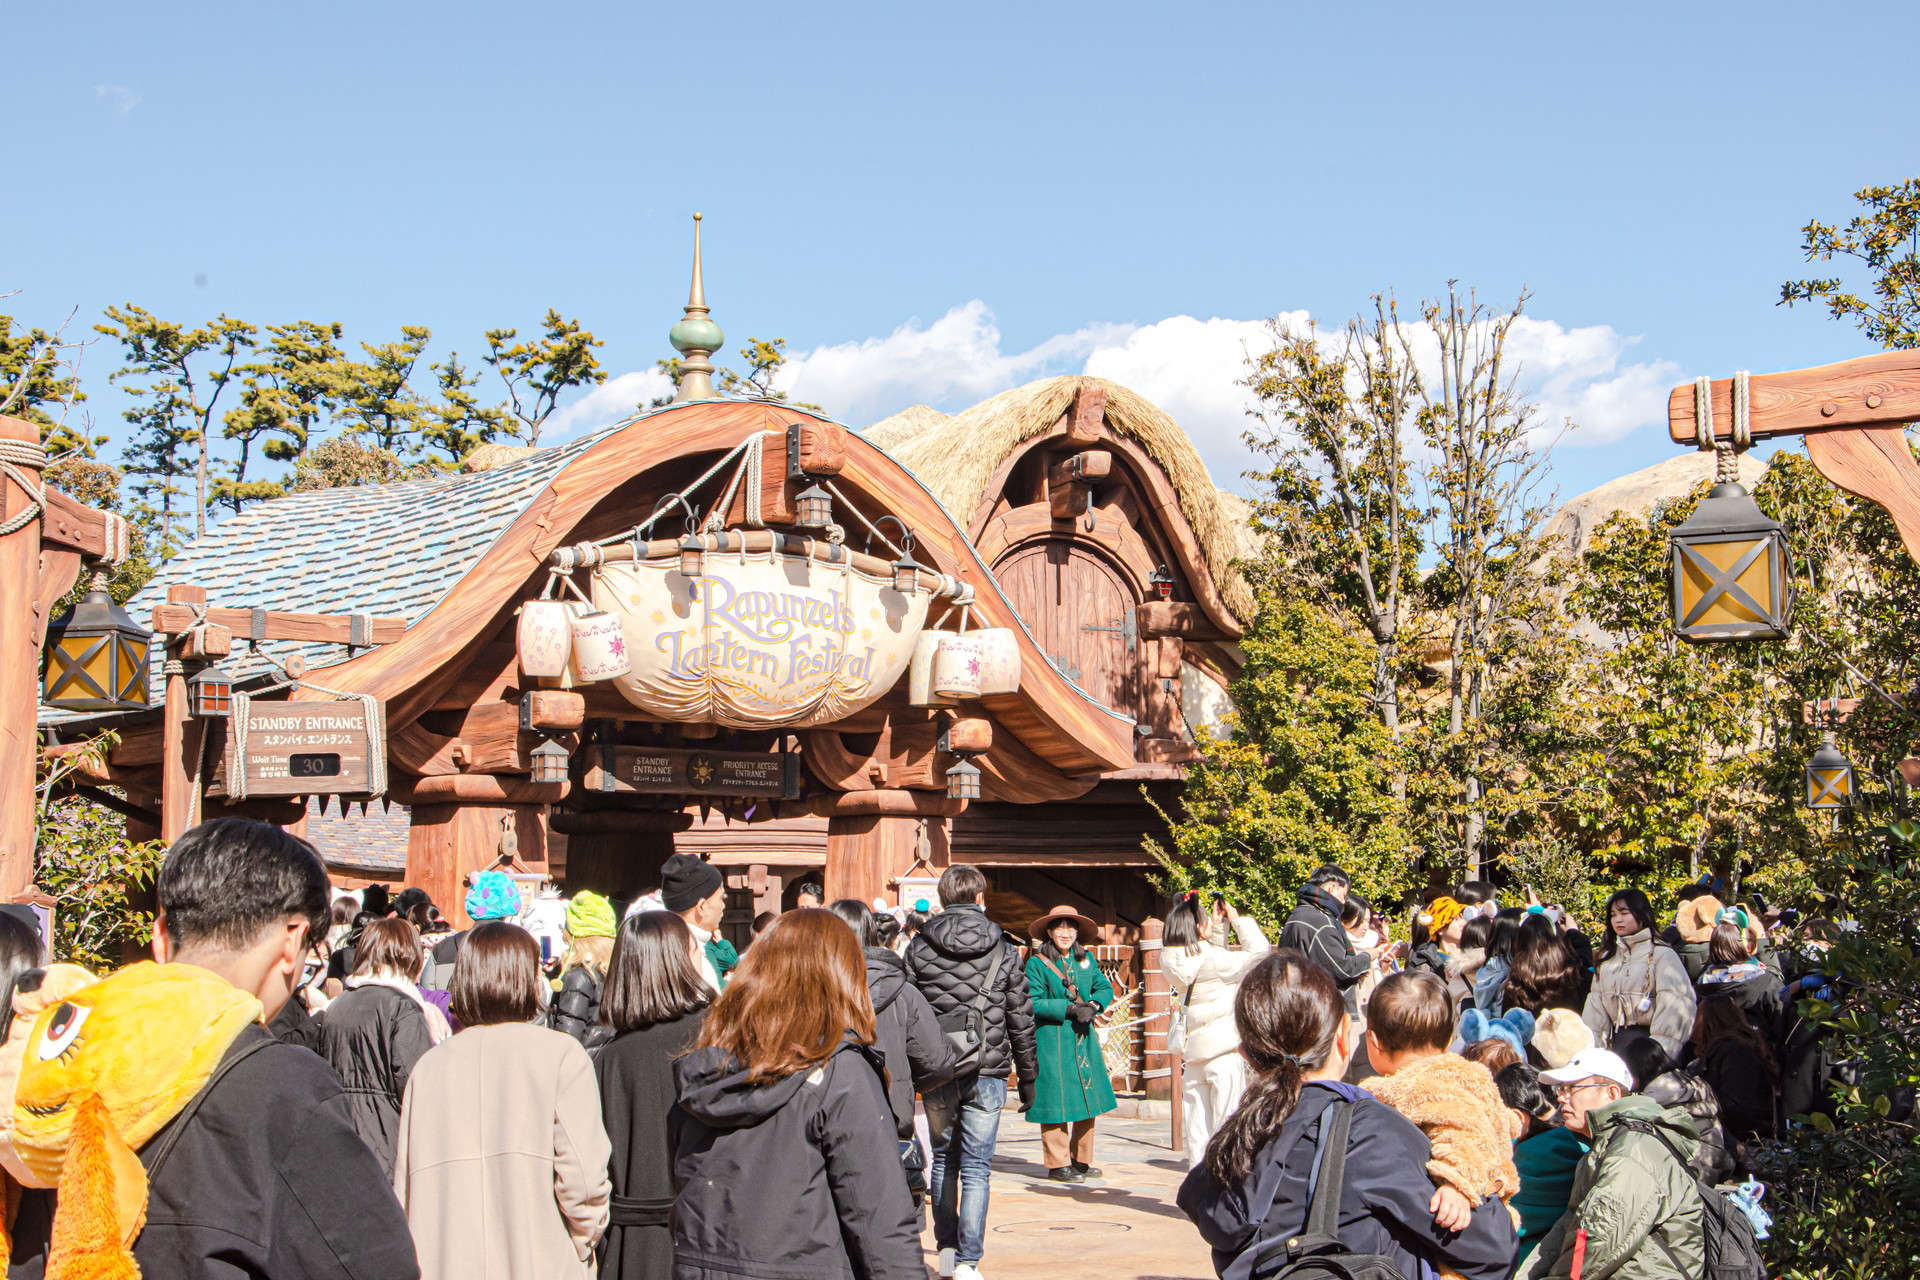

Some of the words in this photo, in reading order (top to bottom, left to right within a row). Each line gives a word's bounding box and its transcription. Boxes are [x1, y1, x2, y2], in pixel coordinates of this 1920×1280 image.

[689, 575, 857, 645] Rapunzel's
[655, 630, 779, 682] Lantern
[779, 634, 877, 689] Festival
[250, 717, 301, 730] STANDBY
[306, 717, 364, 730] ENTRANCE
[264, 734, 353, 745] スタンバイ・エントランス
[252, 755, 270, 763] Wait
[271, 755, 288, 763] Time
[636, 757, 669, 766] STANDBY
[303, 758, 324, 774] 30
[633, 765, 672, 775] ENTRANCE
[723, 760, 755, 769] PRIORITY
[757, 762, 779, 770] ACCESS
[735, 769, 767, 779] ENTRANCE
